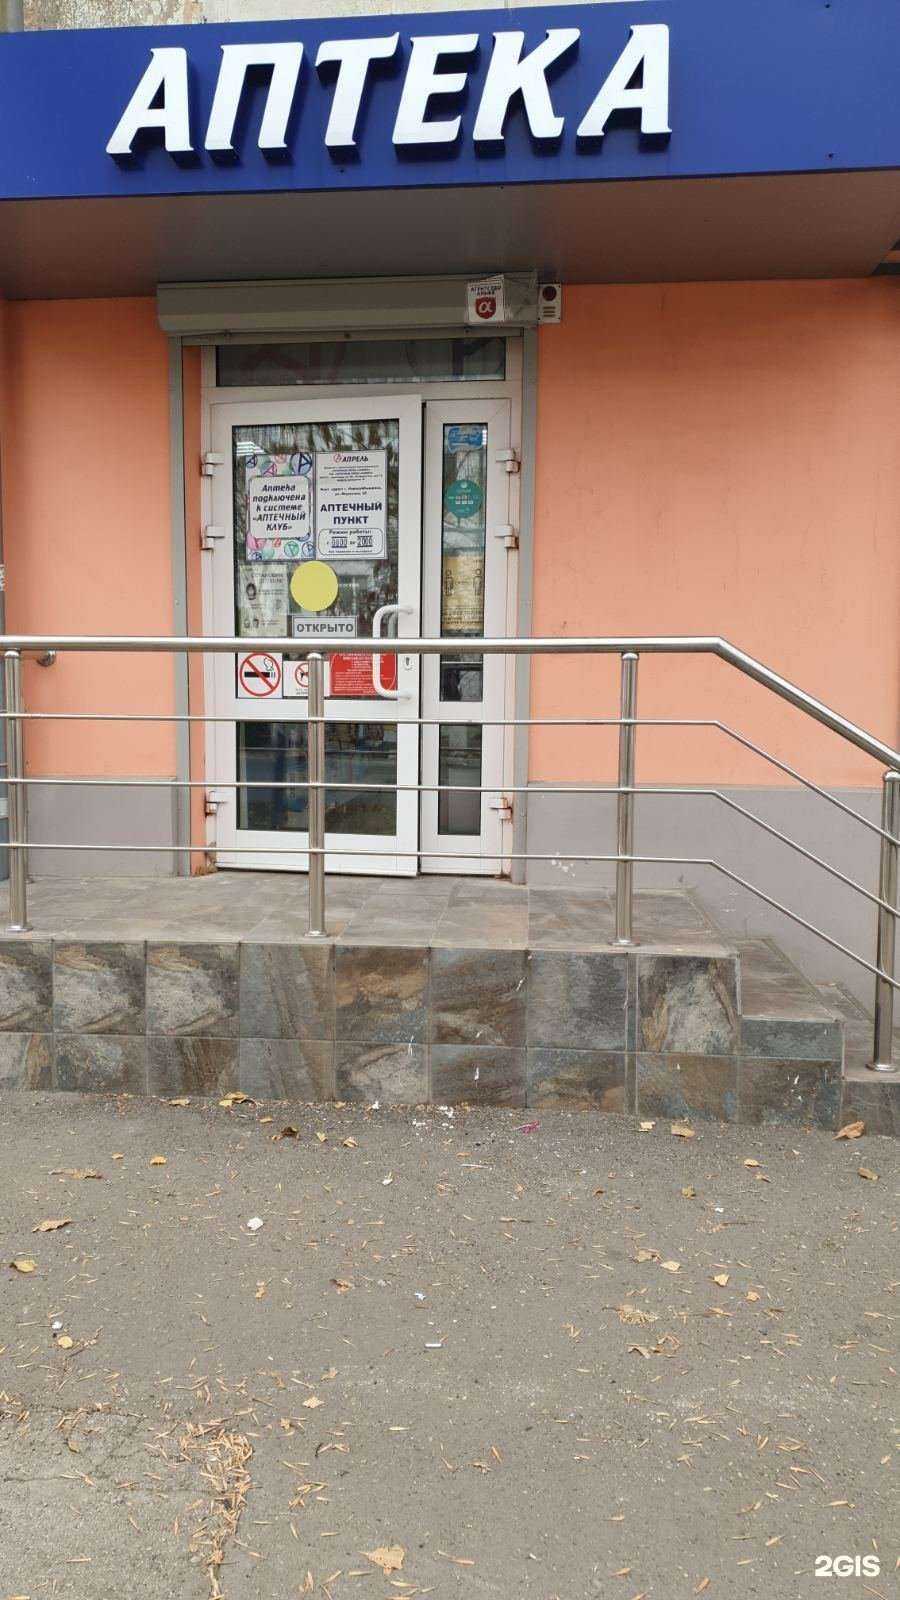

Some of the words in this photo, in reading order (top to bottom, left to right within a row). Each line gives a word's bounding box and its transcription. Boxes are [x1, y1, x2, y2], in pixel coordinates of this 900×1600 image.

[105, 22, 672, 155] АПТЕКА
[341, 455, 369, 463] АПРЕЛЬ
[262, 484, 296, 492] Аптека
[252, 494, 306, 504] подключена
[263, 504, 303, 512] системе
[320, 501, 383, 512] АПТЕЧНЫЙ
[333, 515, 369, 525] ПУНКТ
[296, 623, 354, 633] ОТКРЫТО
